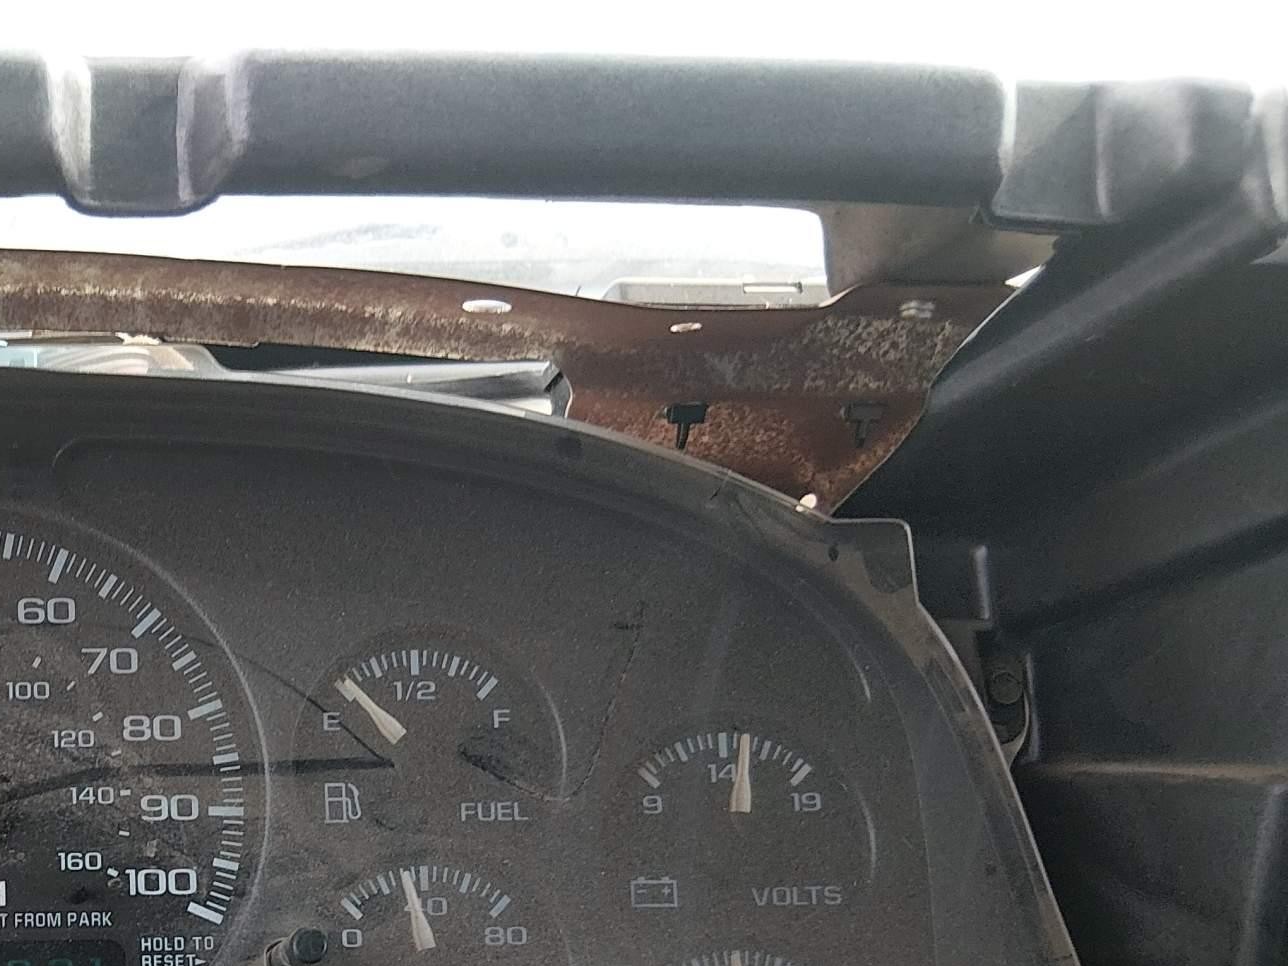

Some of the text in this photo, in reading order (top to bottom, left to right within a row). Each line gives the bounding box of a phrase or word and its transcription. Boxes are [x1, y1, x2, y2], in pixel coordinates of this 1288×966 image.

[16, 597, 76, 624] 60
[81, 647, 139, 674] 70
[6, 680, 50, 700] 100
[393, 680, 436, 702] 1/2
[121, 715, 182, 741] 80
[322, 712, 341, 731] E
[492, 709, 511, 729] F
[51, 729, 95, 748] 120
[69, 787, 114, 806] 140
[643, 795, 663, 815] 9
[791, 792, 822, 811] 19
[139, 794, 200, 820] 90
[460, 802, 529, 822] FUEL
[57, 852, 102, 871] 160
[124, 868, 197, 895] 100
[752, 885, 842, 906] VOLTS
[14, 911, 62, 928] FROM
[67, 911, 113, 927] PARK
[140, 935, 215, 952] HOLD TO
[341, 928, 362, 948] 0
[484, 926, 528, 946] 80
